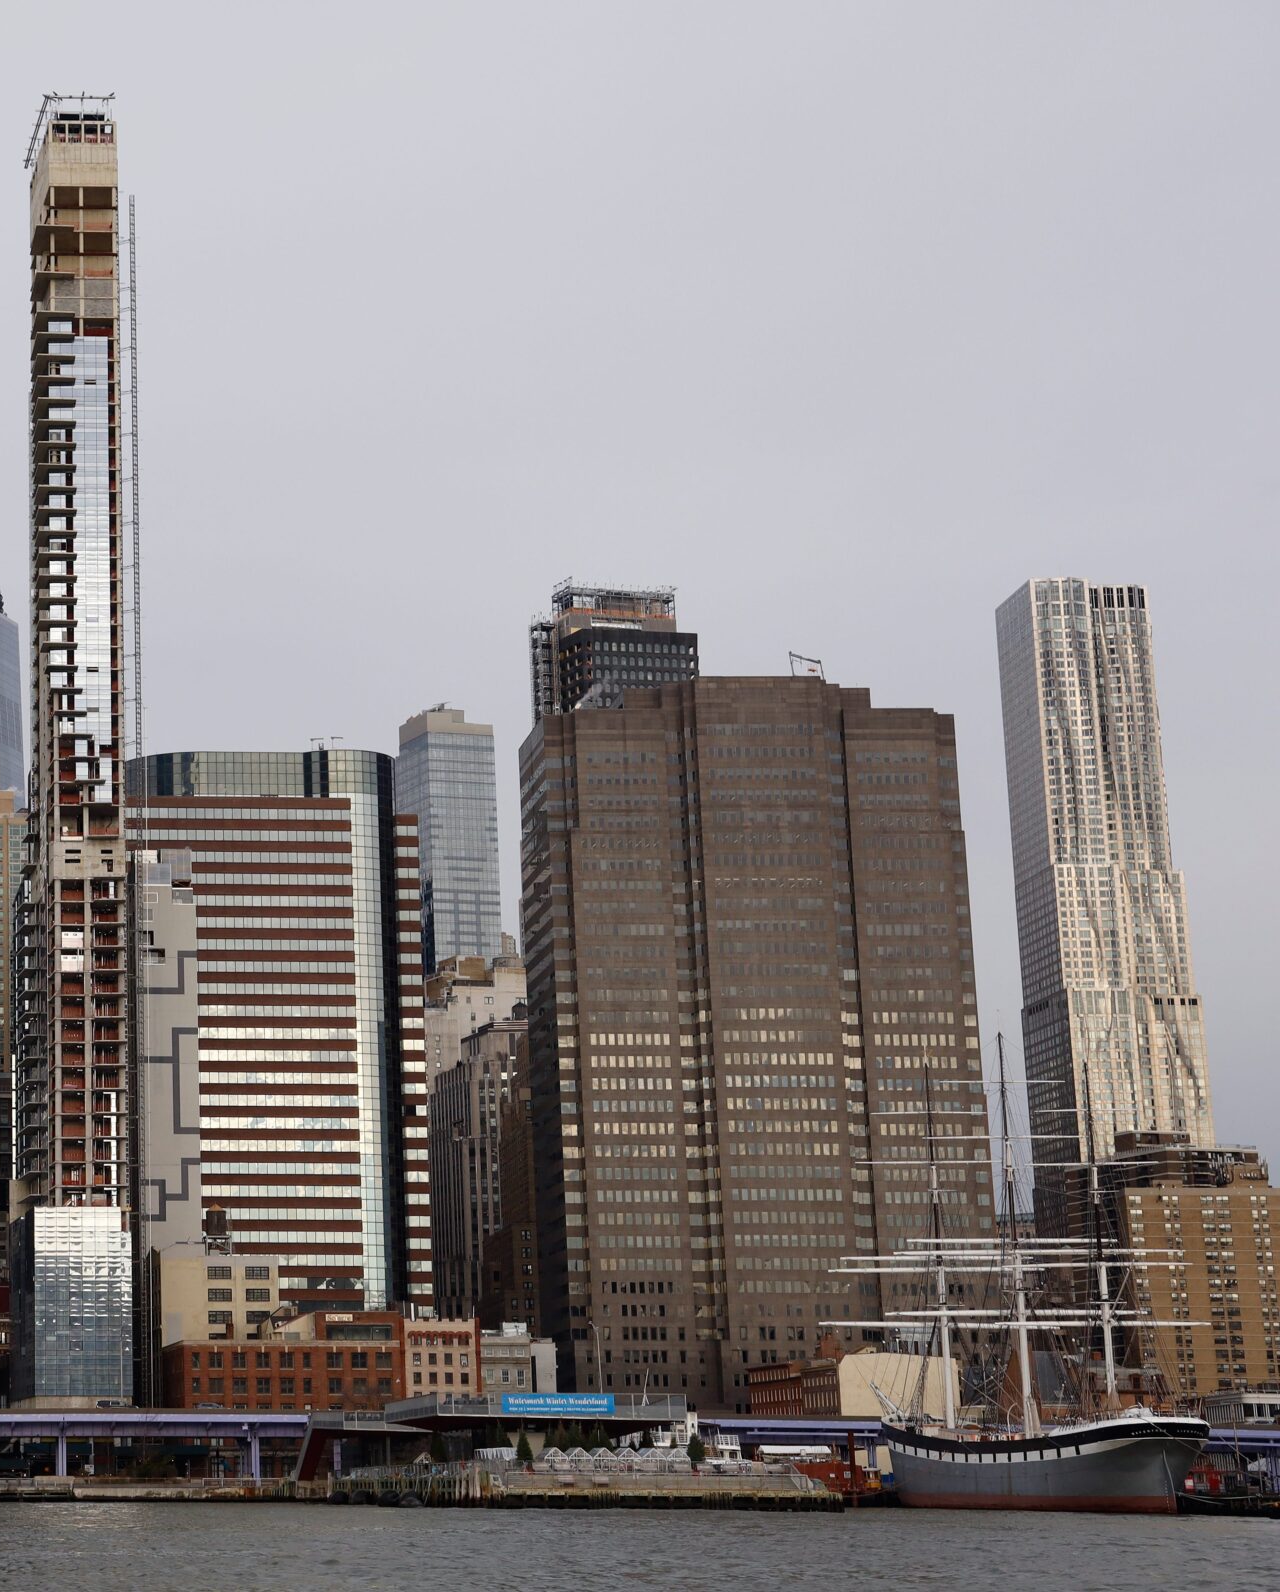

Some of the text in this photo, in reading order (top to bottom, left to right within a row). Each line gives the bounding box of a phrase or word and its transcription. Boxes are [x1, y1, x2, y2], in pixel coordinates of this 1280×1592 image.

[508, 1397, 608, 1405] Watermark Winter Wonderland
